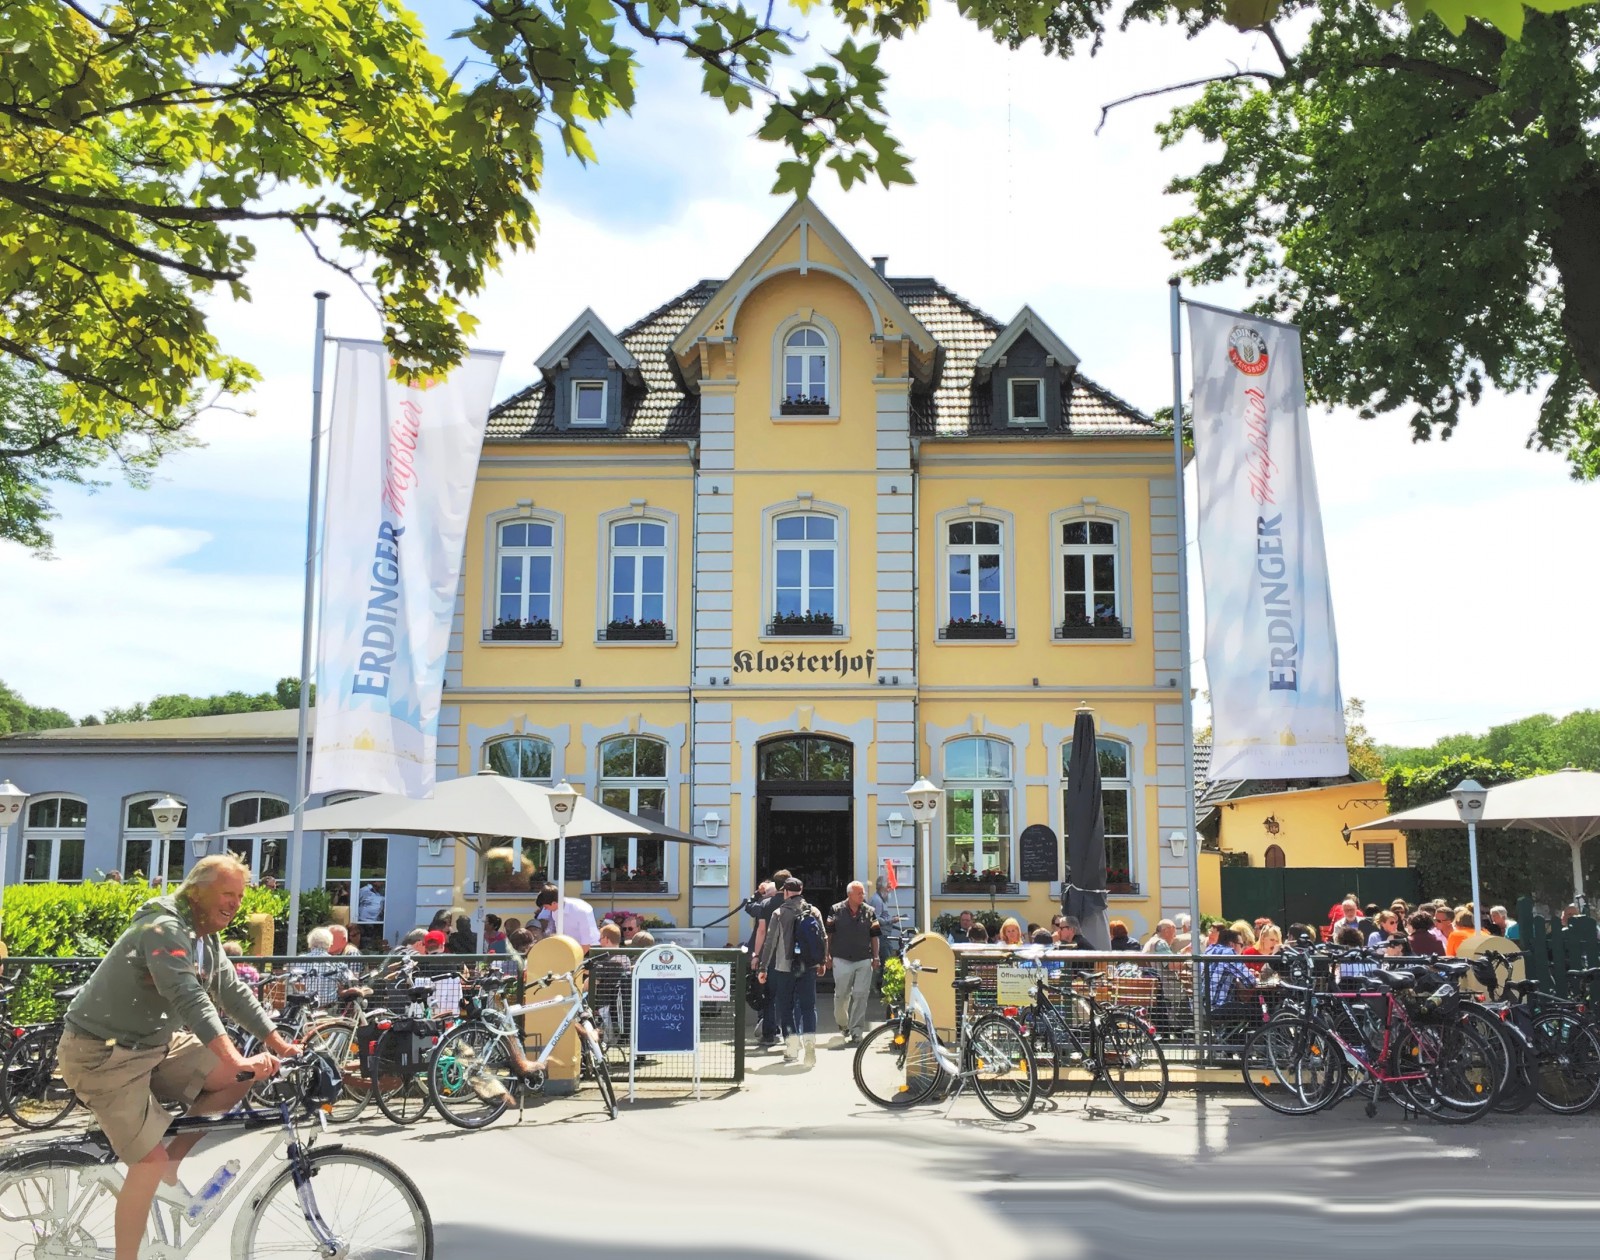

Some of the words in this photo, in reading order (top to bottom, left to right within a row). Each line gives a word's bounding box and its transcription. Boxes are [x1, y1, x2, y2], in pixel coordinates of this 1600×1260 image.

[352, 520, 406, 698] ERDINGER
[1256, 512, 1298, 692] ERDINGER
[733, 649, 875, 679] Klosterhof
[651, 963, 682, 971] ERDINGER
